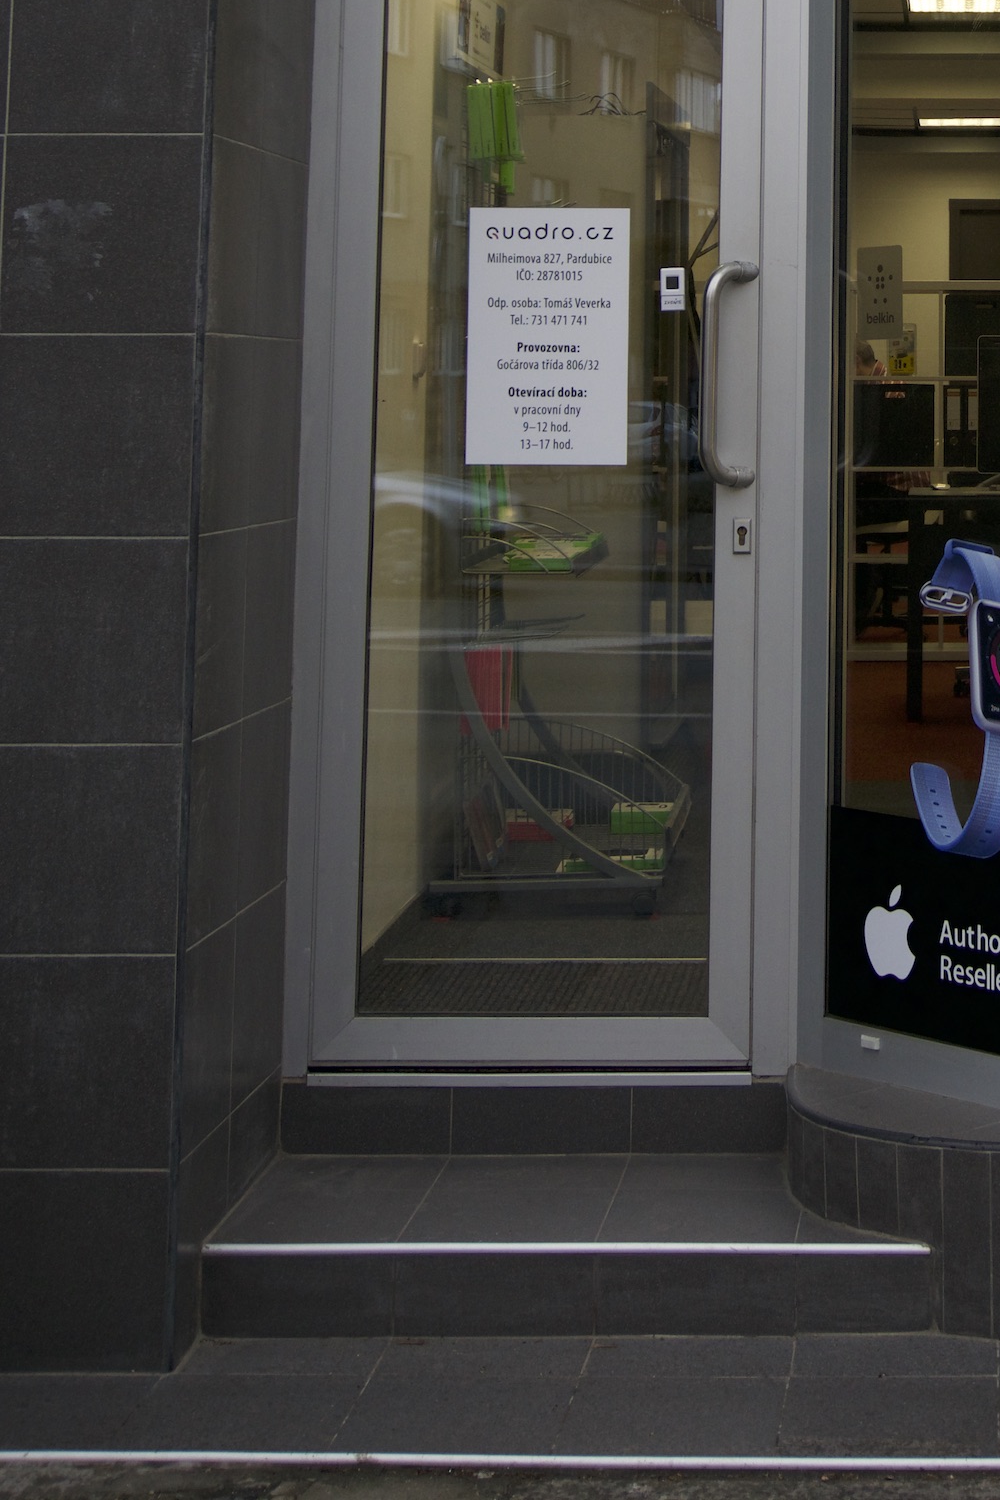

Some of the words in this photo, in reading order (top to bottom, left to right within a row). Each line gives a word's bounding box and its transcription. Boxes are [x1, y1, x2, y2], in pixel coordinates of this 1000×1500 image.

[487, 252, 541, 264] Milheimova
[543, 253, 564, 266] 827,
[567, 252, 613, 264] Pardubice
[516, 268, 534, 281] IČO:
[536, 270, 583, 281] 28781015
[487, 296, 509, 311] Odp.
[511, 297, 541, 309] osoba:
[543, 297, 573, 309] Tomáš
[575, 297, 611, 309] Veverka
[509, 314, 529, 326] Tel.:
[531, 314, 548, 326] 731
[550, 314, 567, 326] 471
[571, 314, 587, 326] 741
[866, 312, 895, 324] belkin
[517, 341, 580, 354] Provozovna:
[496, 358, 539, 371] Gočárova
[541, 358, 564, 370] třída
[566, 359, 599, 371] 806/32
[508, 386, 555, 398] Otevírací
[557, 386, 587, 398] doba:
[513, 406, 519, 415] v
[521, 404, 562, 418] pracovní
[563, 403, 581, 418] dny
[550, 421, 571, 433] hod.
[552, 438, 574, 451] hod.
